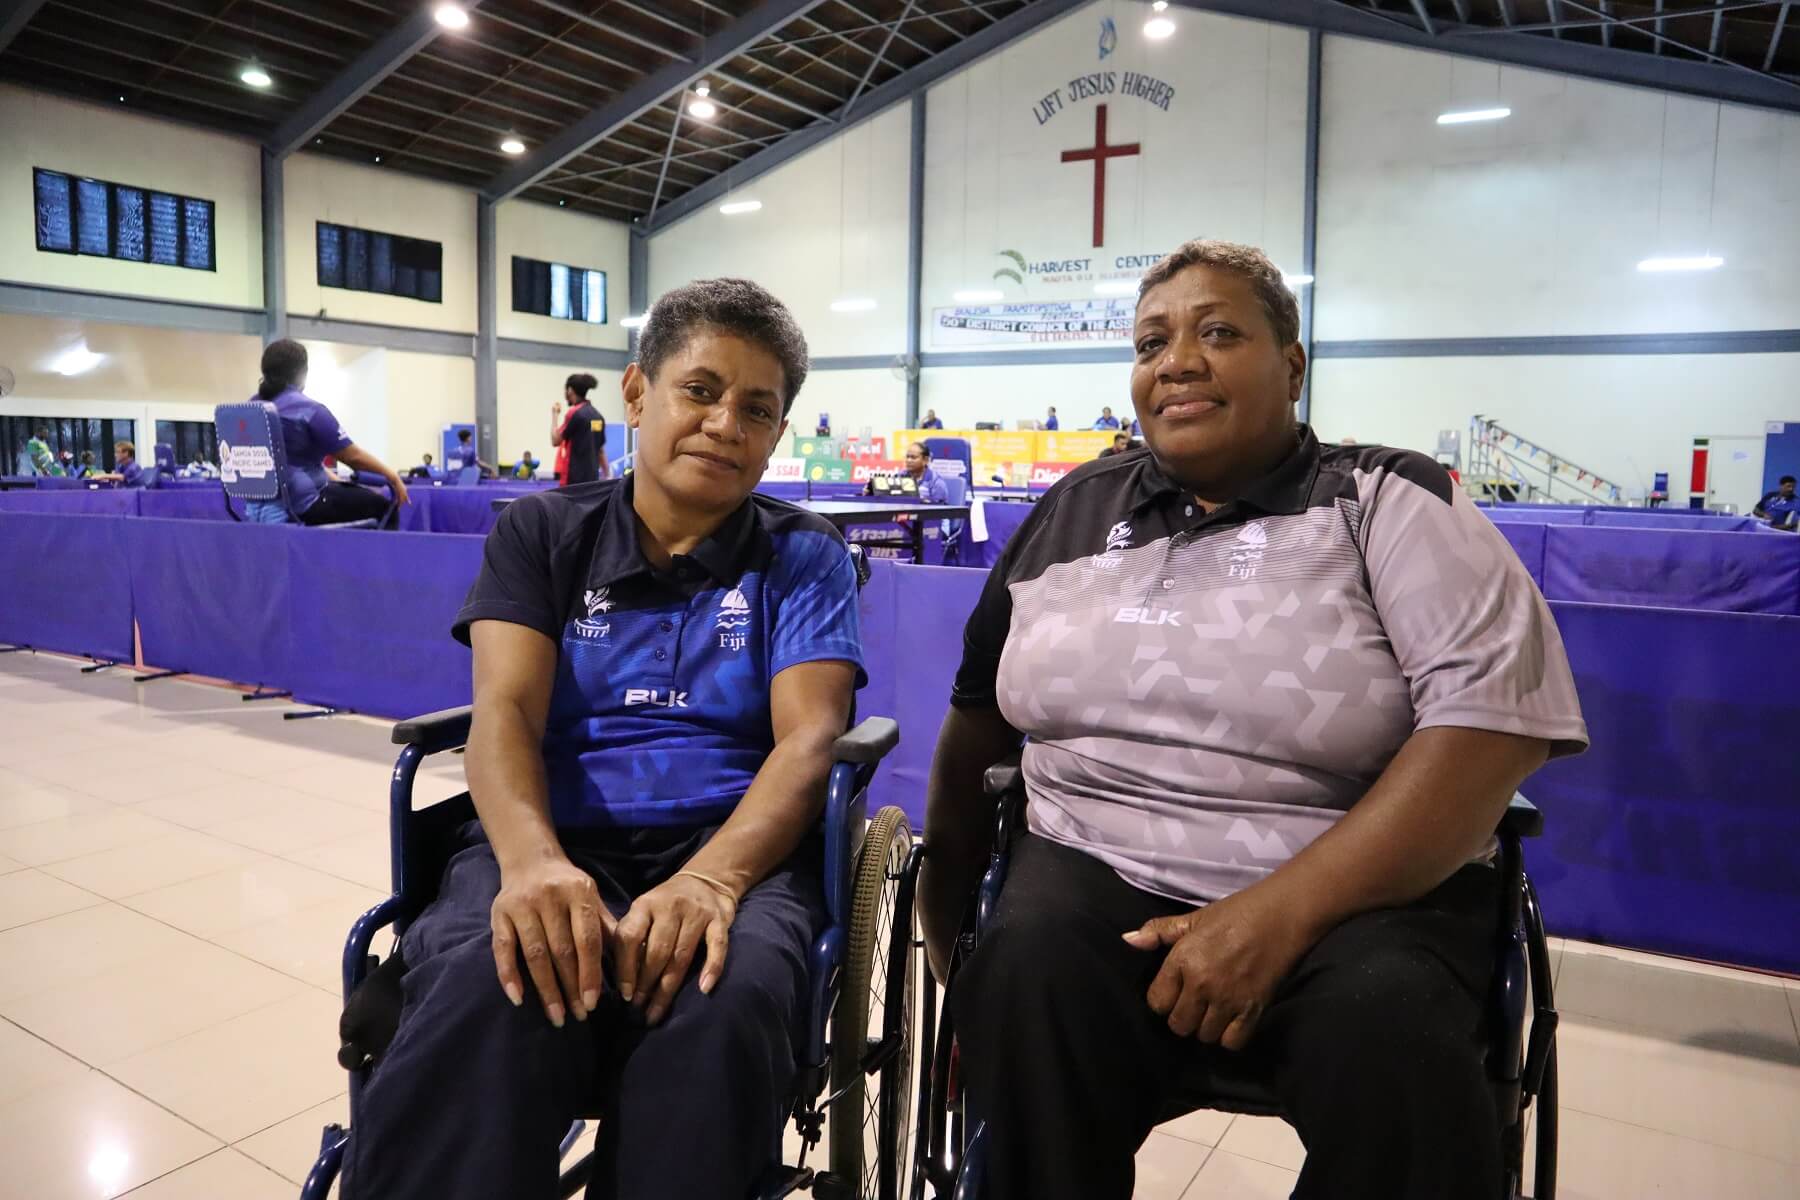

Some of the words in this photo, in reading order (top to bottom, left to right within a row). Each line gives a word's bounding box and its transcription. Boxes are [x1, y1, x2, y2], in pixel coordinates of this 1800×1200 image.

[1032, 88, 1064, 125] LIFT
[1068, 71, 1116, 102] JESUS
[1121, 71, 1175, 111] HIGHER
[1029, 258, 1091, 274] HARVEST
[966, 318, 1018, 333] DISTRICT
[1228, 563, 1256, 580] Fiji
[1113, 607, 1183, 627] BLK
[719, 632, 746, 651] Fiji
[624, 688, 689, 708] BLK
